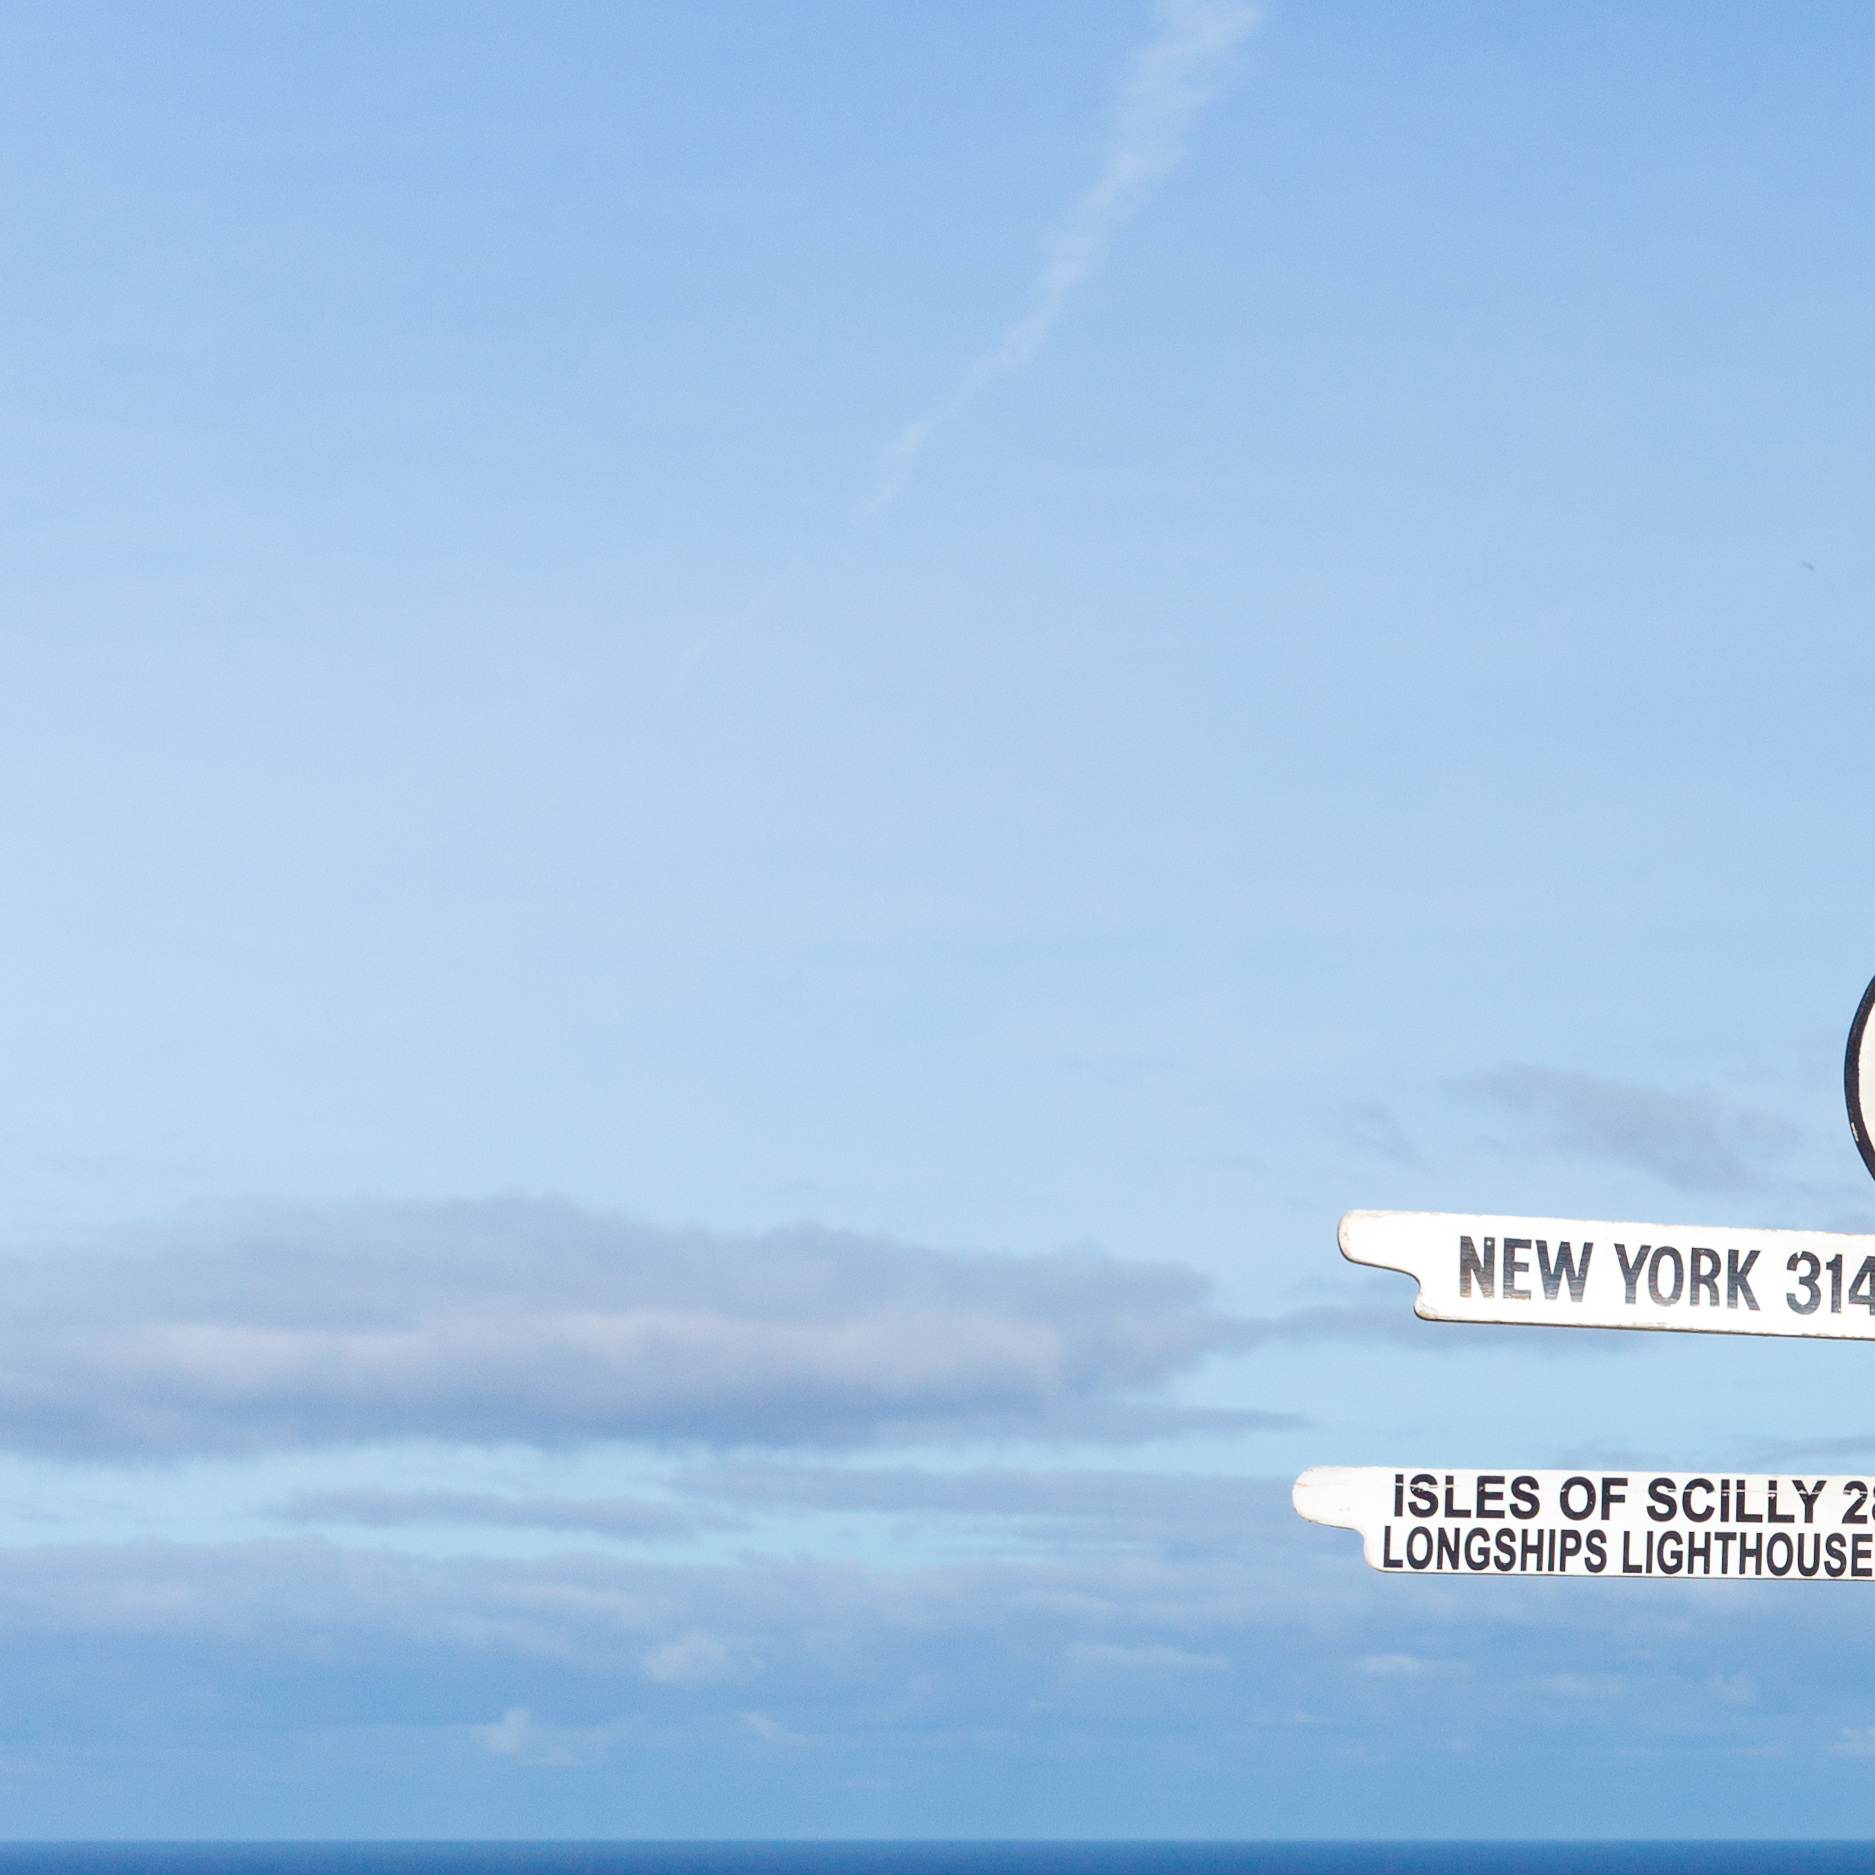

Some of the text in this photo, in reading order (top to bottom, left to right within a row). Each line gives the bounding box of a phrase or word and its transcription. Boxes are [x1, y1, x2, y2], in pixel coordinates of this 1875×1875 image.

[1460, 1236, 1593, 1302] NEW
[1614, 1244, 1760, 1310] YORK
[1394, 1474, 1540, 1519] ISLES
[1560, 1477, 1628, 1520] OF
[1647, 1478, 1827, 1523] SCILLY
[1383, 1526, 1607, 1573] LONGSHIPS
[1622, 1530, 1873, 1577] LIGHTHOUSE
